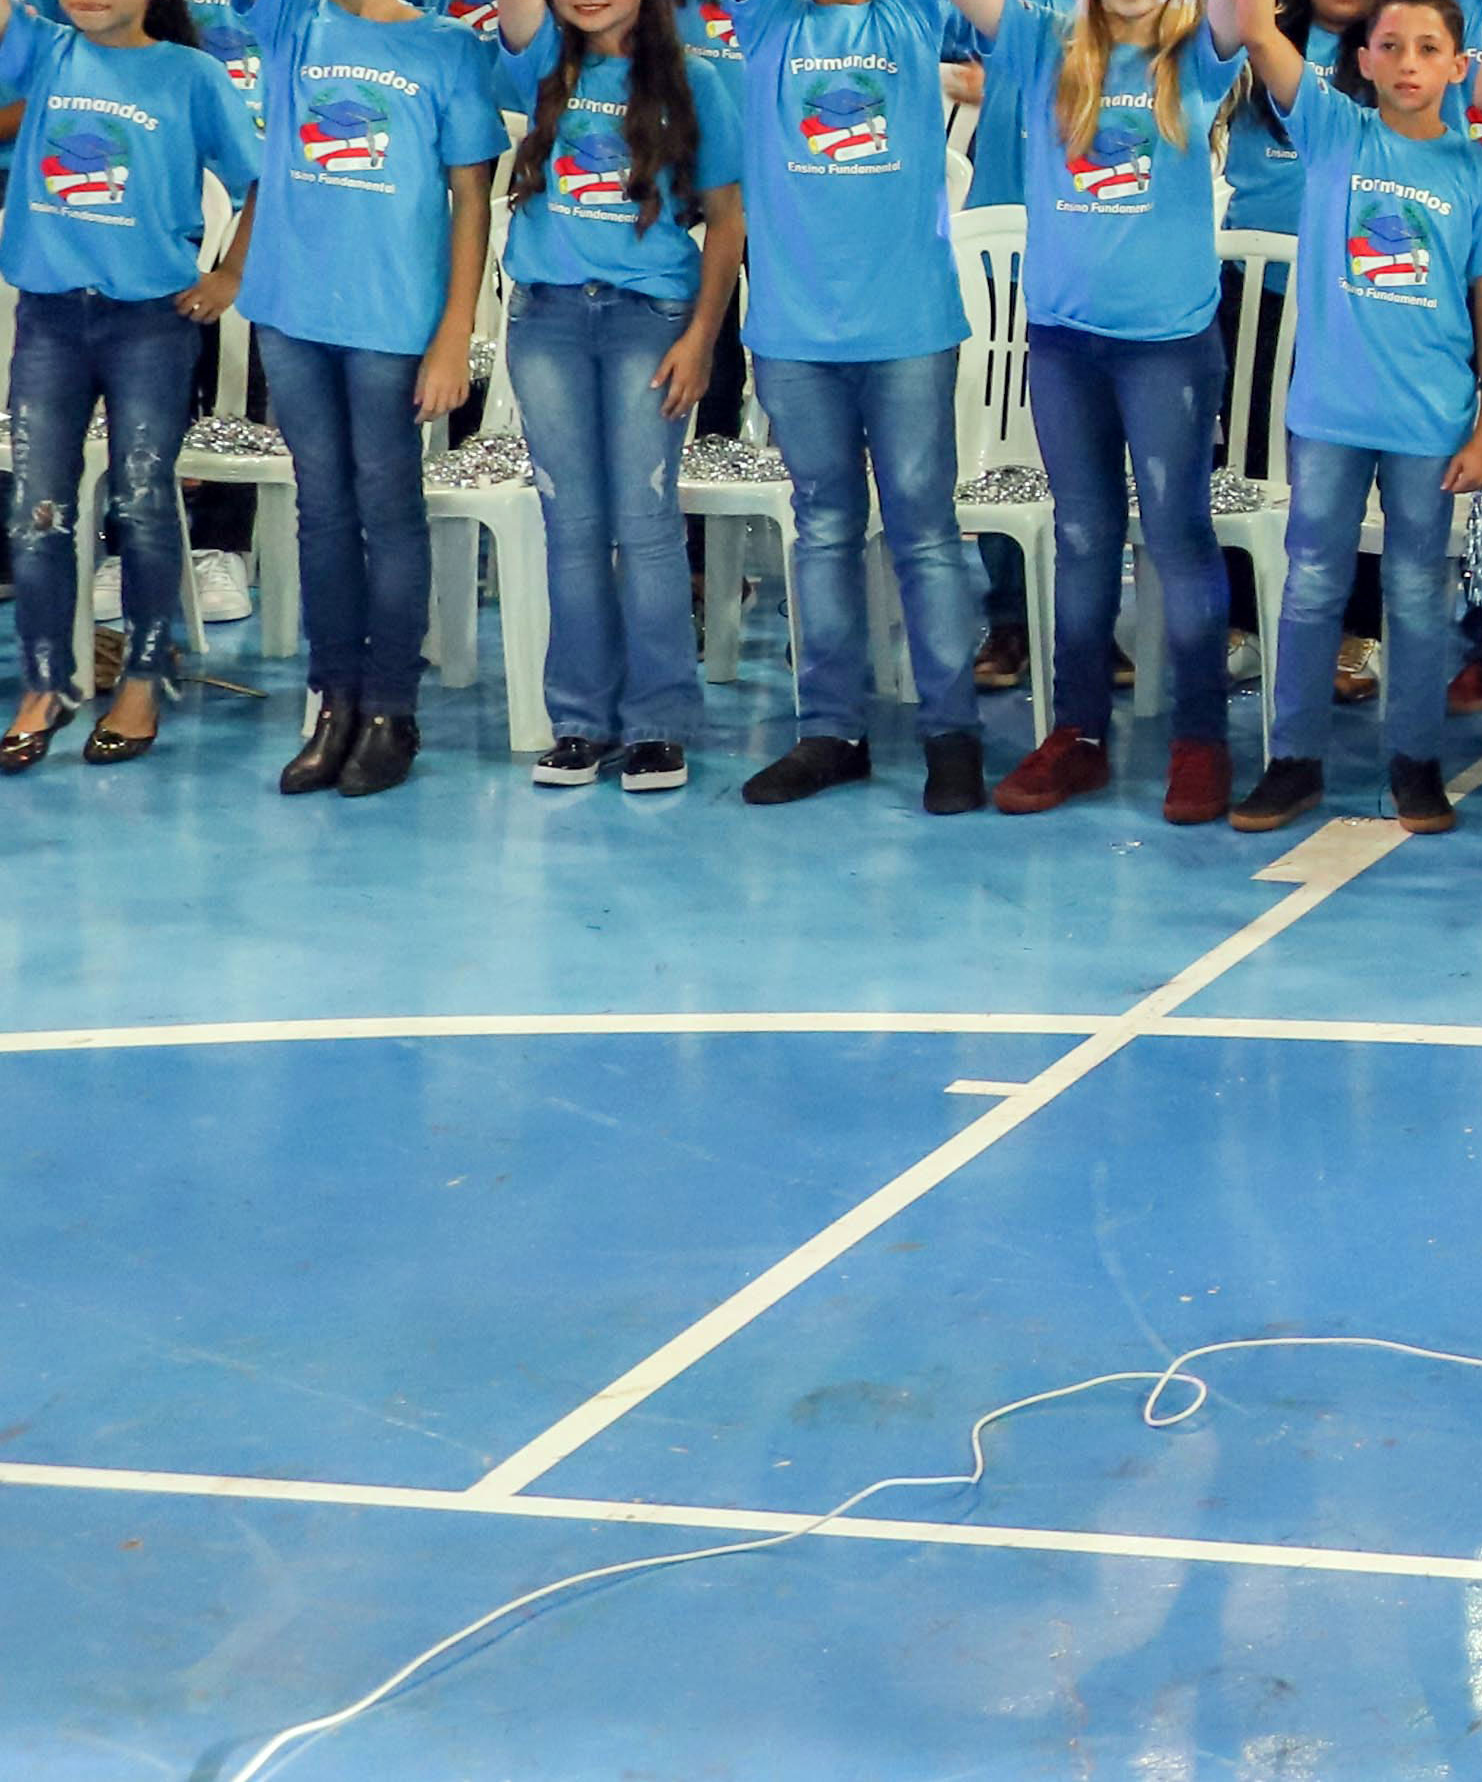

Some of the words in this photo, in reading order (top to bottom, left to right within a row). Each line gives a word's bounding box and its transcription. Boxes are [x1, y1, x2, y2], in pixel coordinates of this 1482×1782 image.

[791, 54, 898, 75] Formandos
[49, 96, 158, 131] ormandos
[828, 161, 901, 175] Fundamental
[1351, 174, 1452, 216] Formandos
